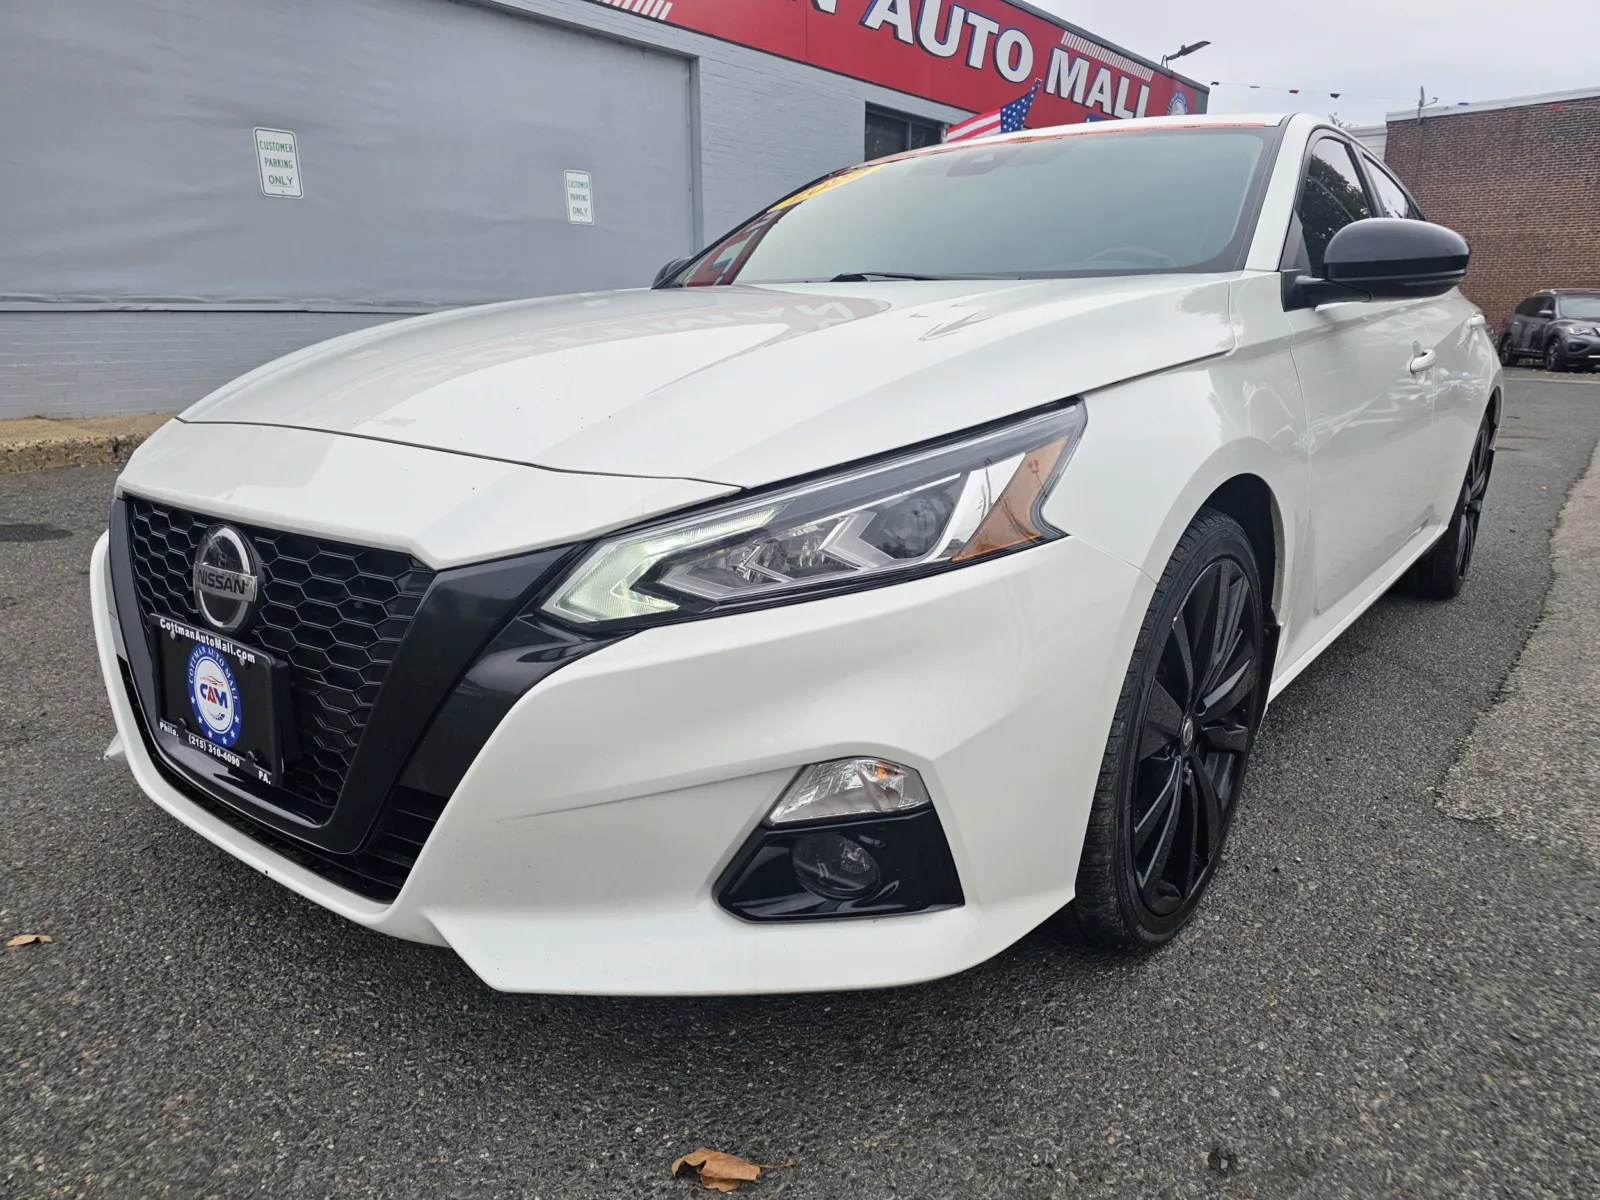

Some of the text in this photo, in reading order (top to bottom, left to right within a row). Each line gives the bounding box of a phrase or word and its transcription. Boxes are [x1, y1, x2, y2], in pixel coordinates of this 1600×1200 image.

[861, 0, 1033, 84] AUTO
[259, 140, 294, 153] CUSTOMER
[264, 157, 293, 170] PARKING
[268, 174, 293, 186] ONLY
[572, 206, 588, 215] ONLY
[197, 567, 246, 595] NISSAN
[160, 618, 256, 664] CottmanAutoMall.com
[207, 647, 225, 667] AUTO
[224, 668, 240, 703] MALL
[199, 683, 228, 709] CAM
[159, 721, 271, 785] Phila. (215) 310-4090 PA.
